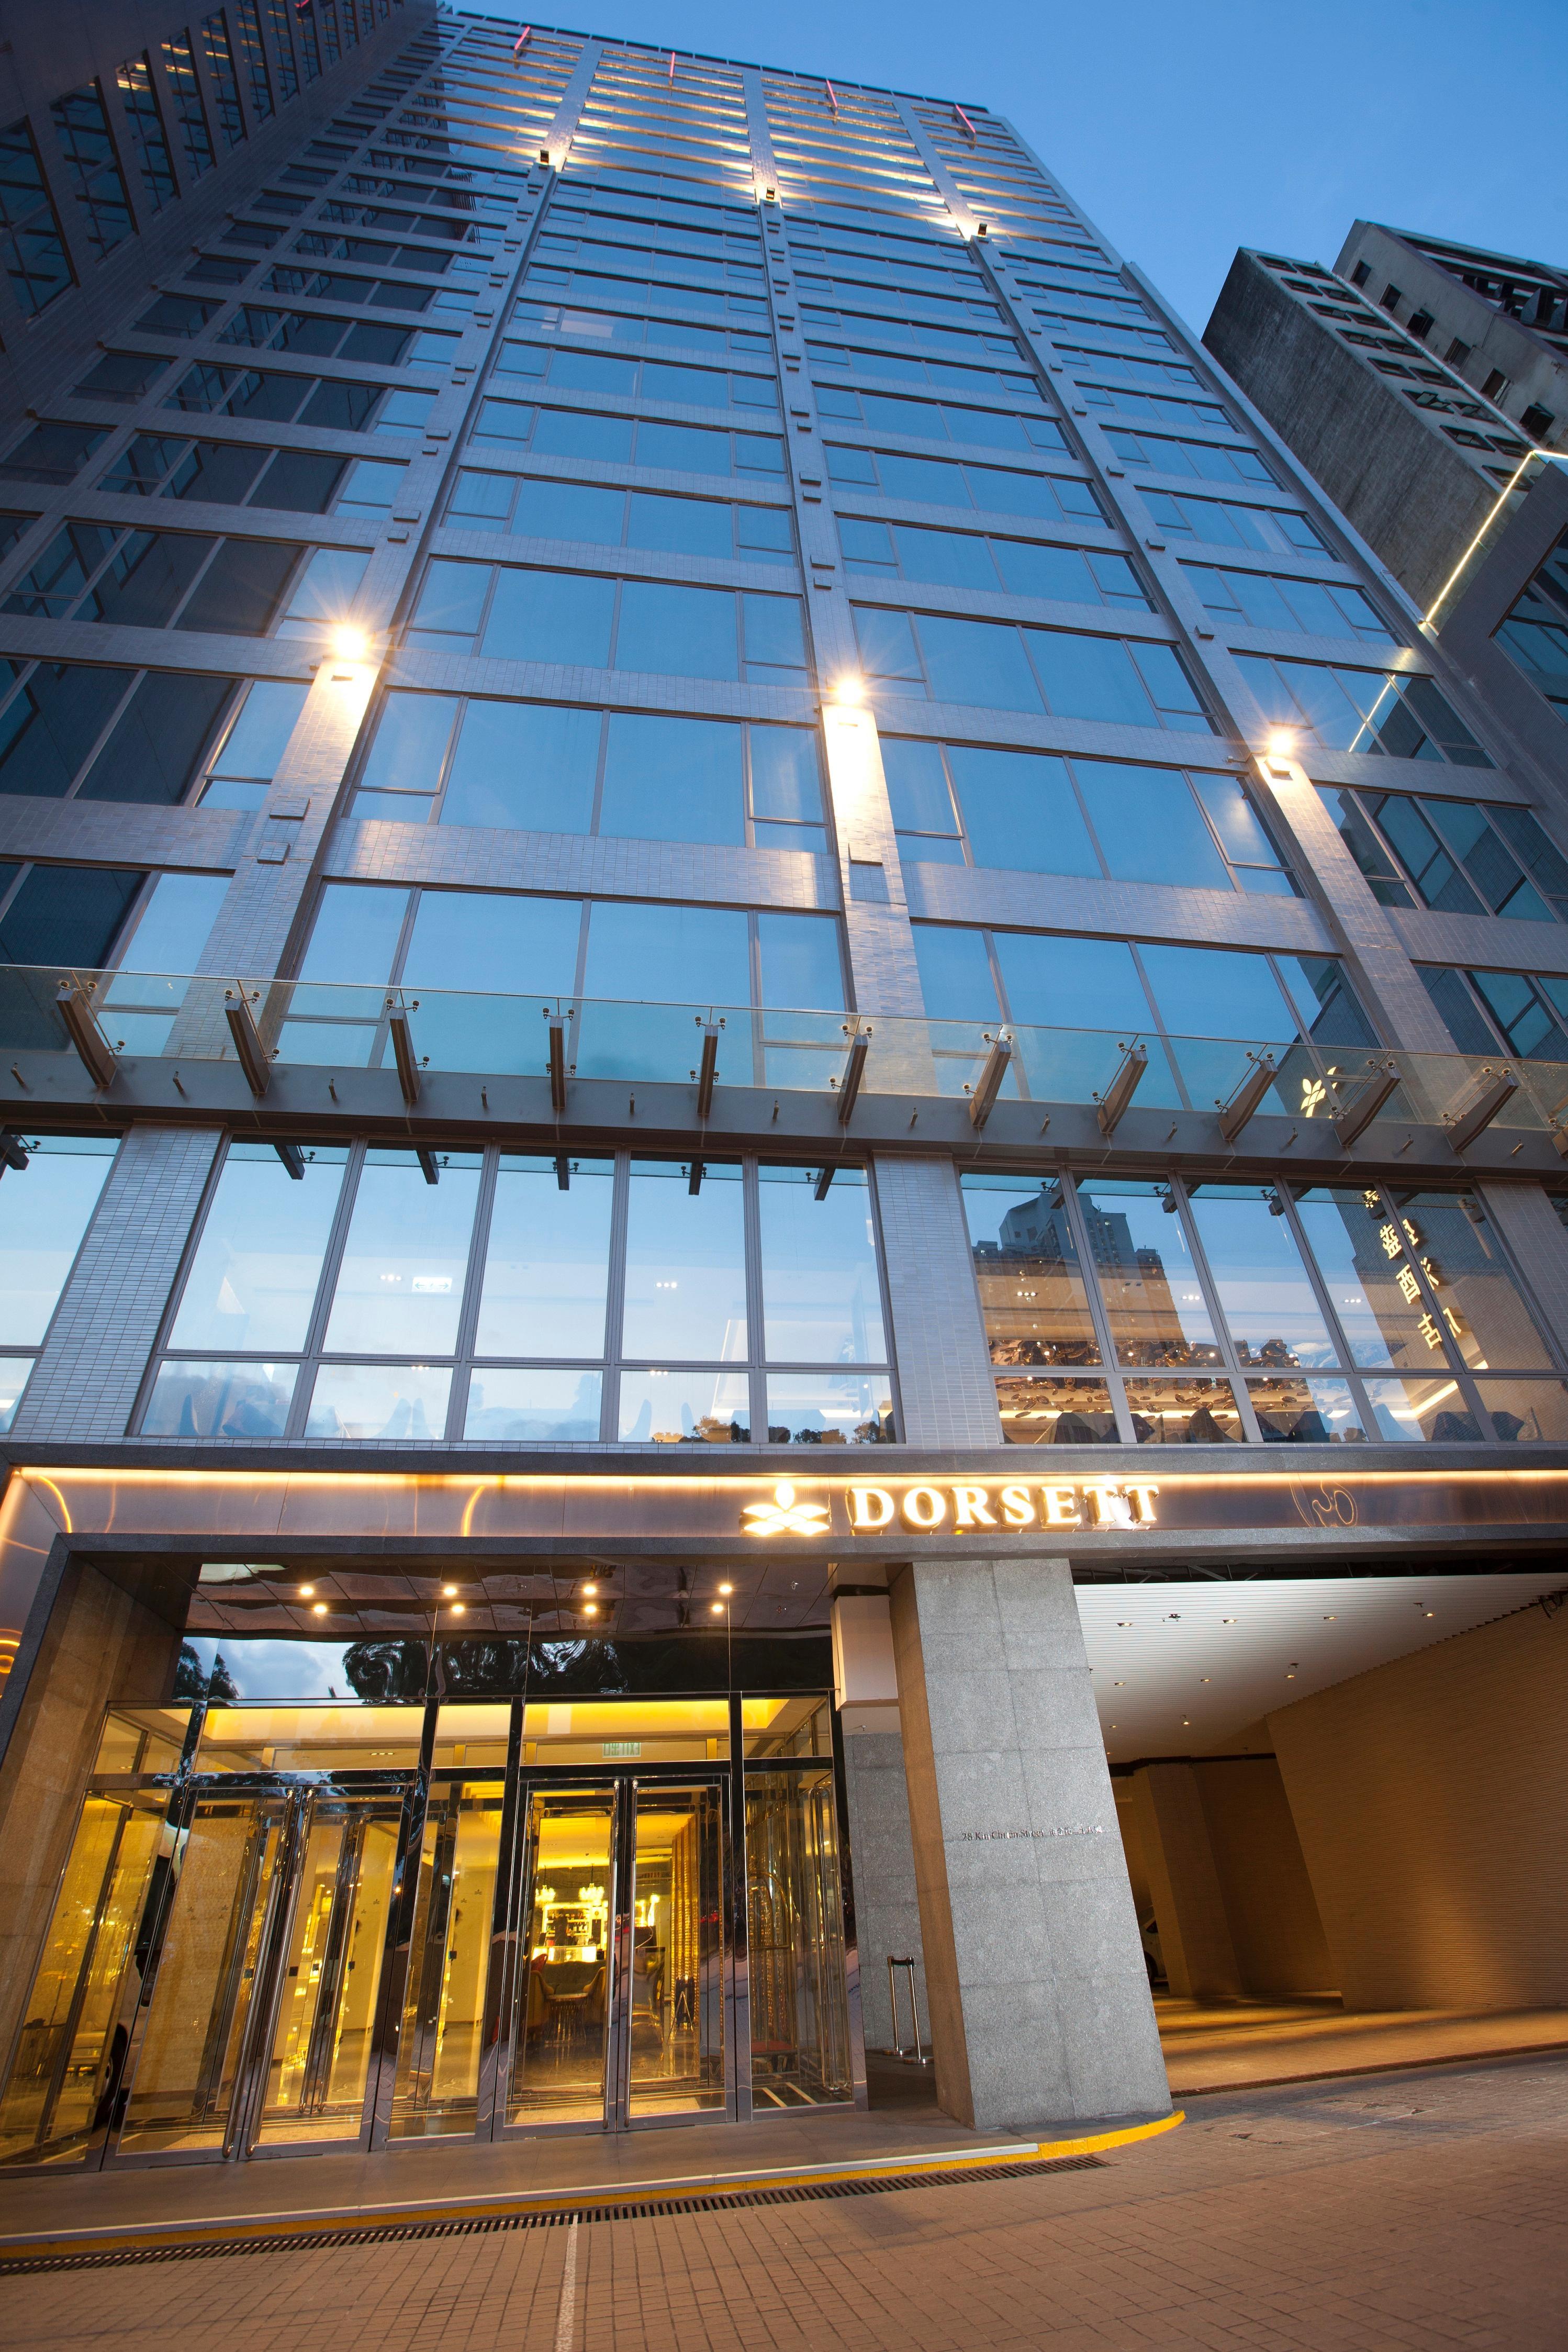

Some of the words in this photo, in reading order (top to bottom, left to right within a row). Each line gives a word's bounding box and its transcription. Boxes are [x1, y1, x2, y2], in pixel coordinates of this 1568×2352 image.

[849, 1485, 1159, 1529] DORSETT
[962, 1833, 973, 1842] 28
[975, 1832, 990, 1841] Kin
[1021, 1829, 1044, 1838] Street
